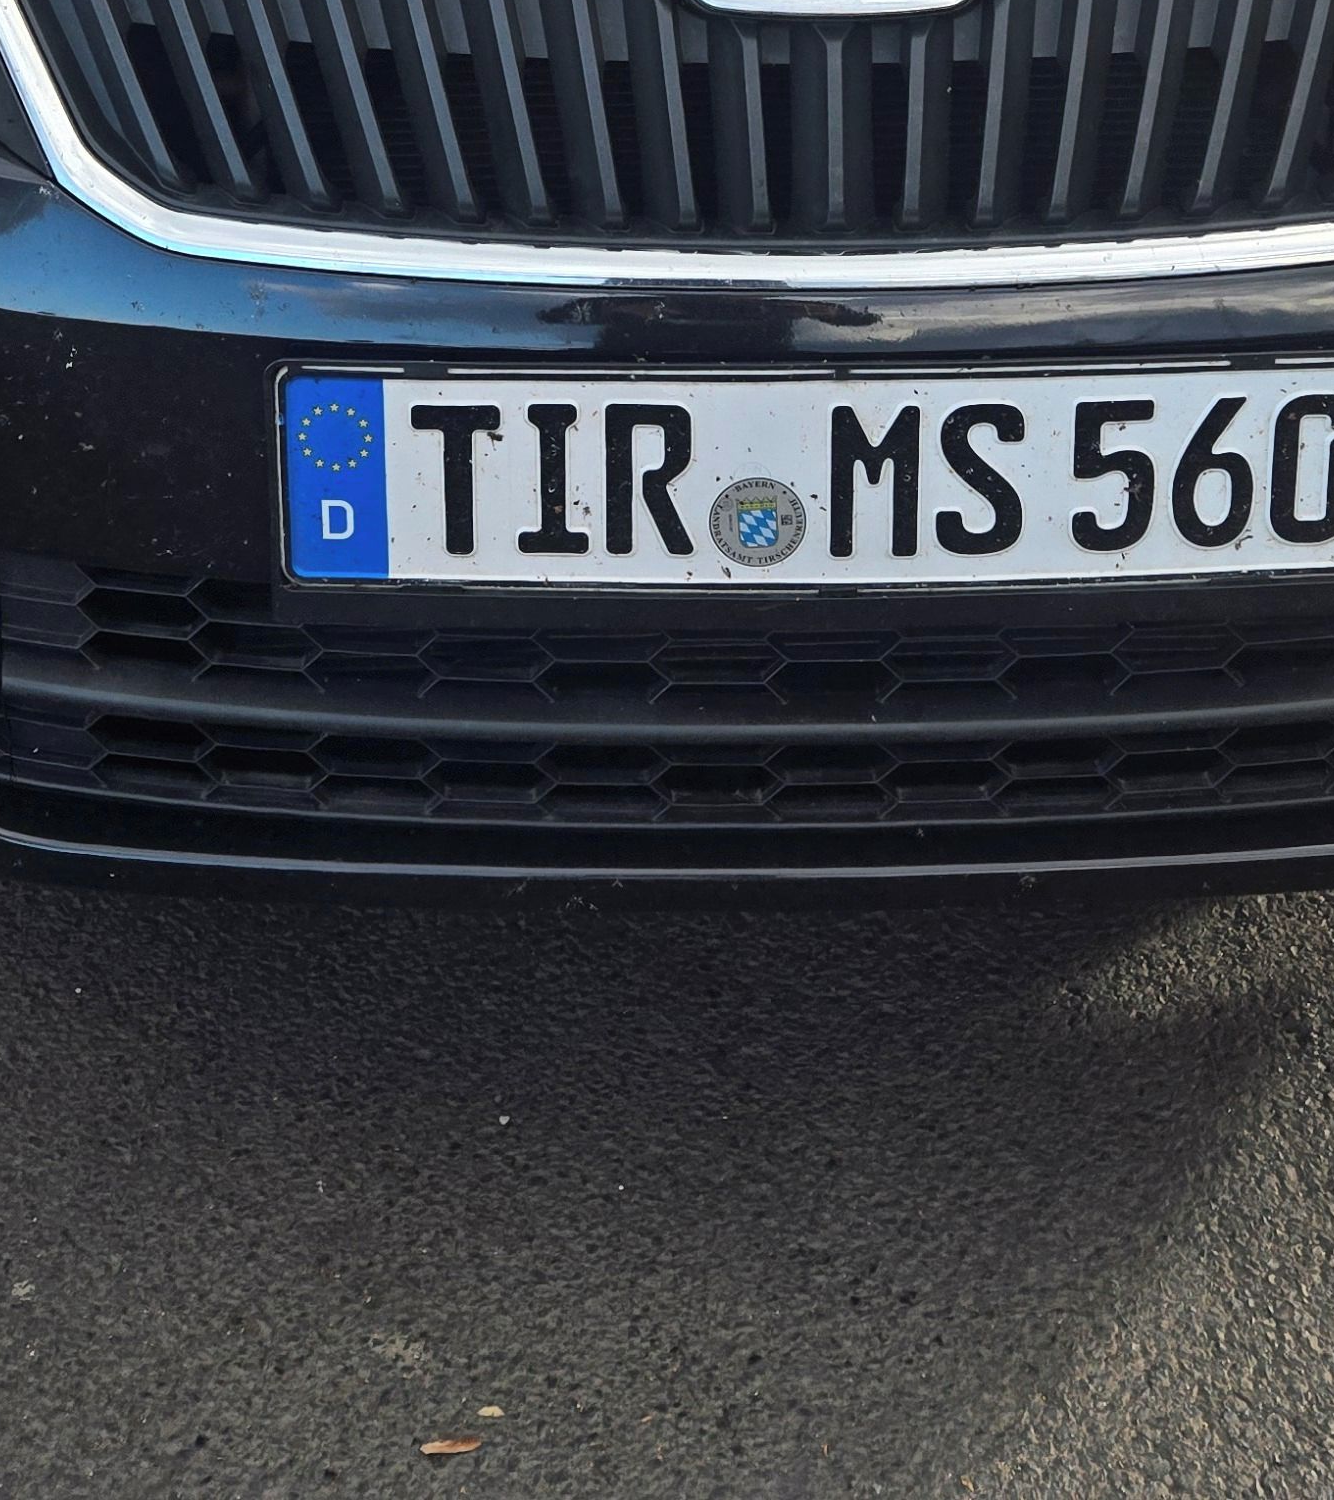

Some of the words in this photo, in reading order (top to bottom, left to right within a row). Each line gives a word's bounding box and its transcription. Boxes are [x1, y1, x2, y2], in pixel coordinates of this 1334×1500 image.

[410, 403, 696, 556] TIR
[829, 403, 1025, 557] MS
[734, 480, 776, 493] BAYERN
[321, 499, 354, 540] D
[712, 503, 754, 564] LANDRATSAMT
